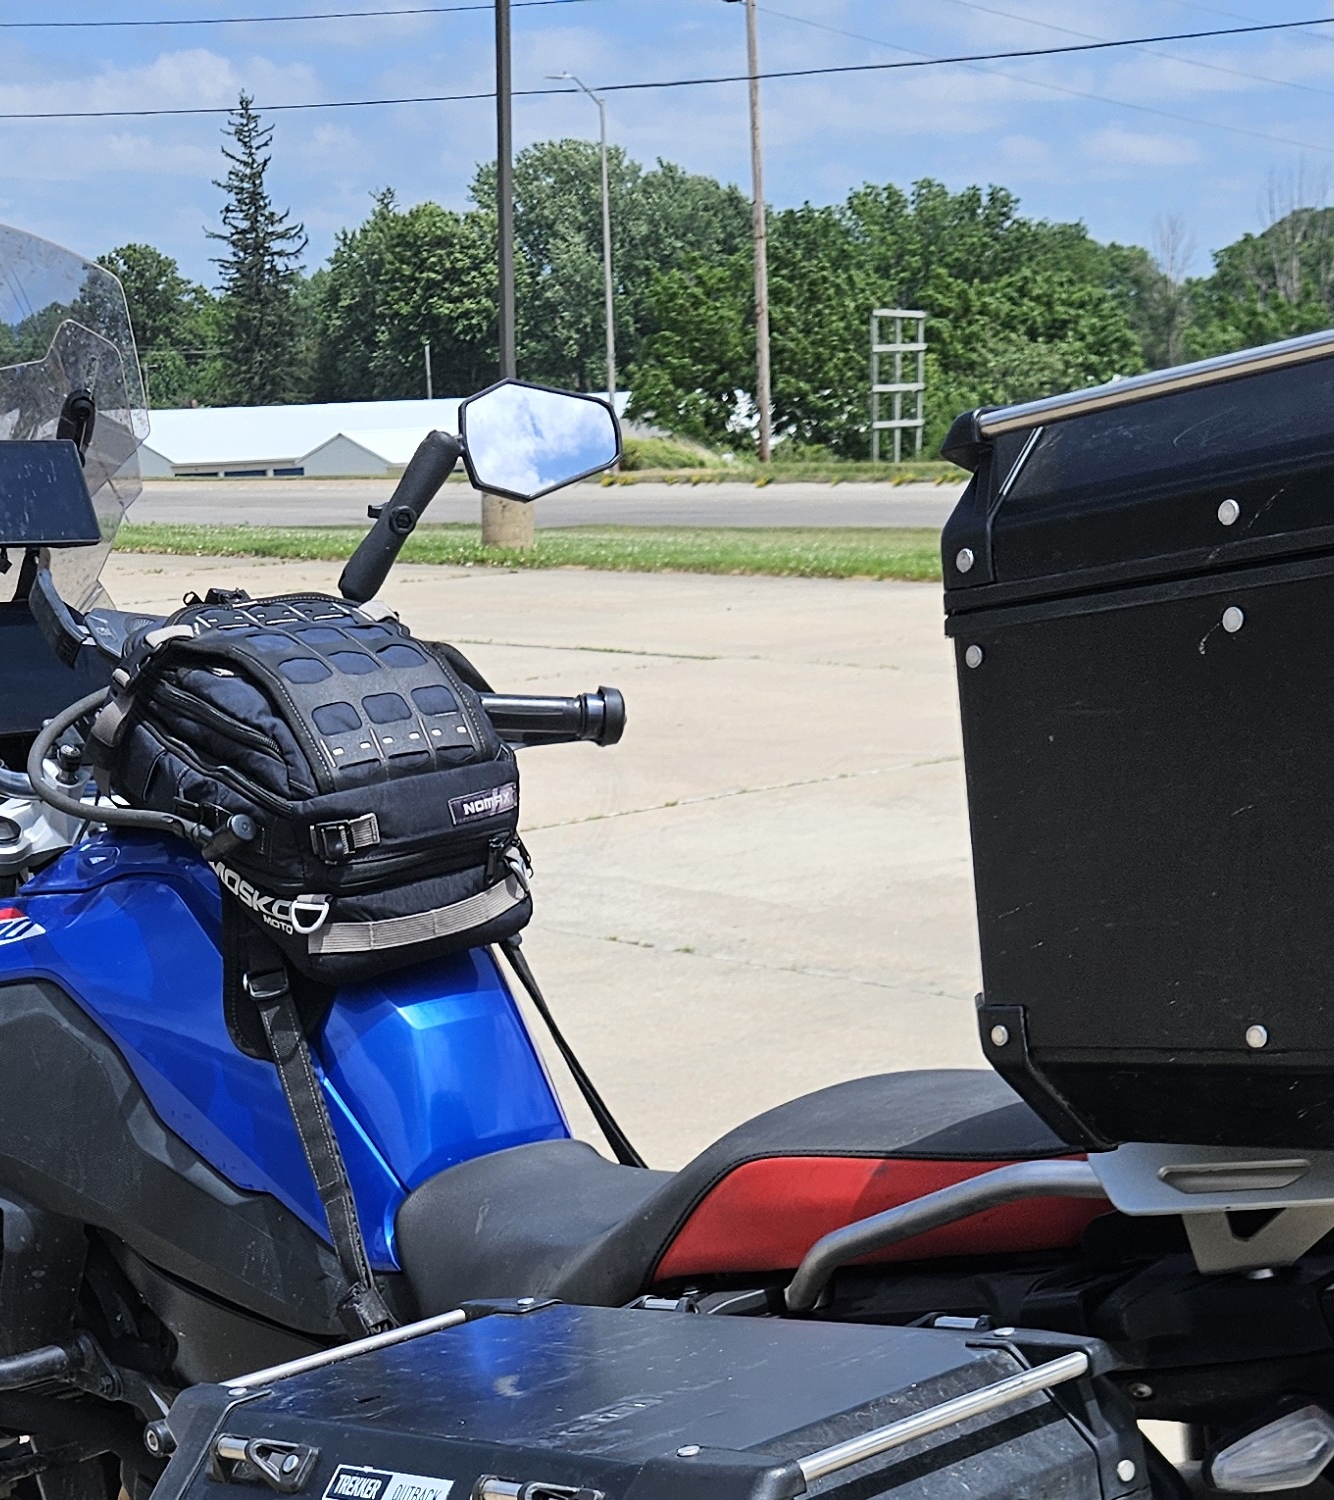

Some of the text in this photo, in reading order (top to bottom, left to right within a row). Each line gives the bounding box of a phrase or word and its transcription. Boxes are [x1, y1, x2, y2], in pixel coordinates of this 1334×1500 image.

[208, 861, 293, 922] MOSKO
[263, 914, 294, 935] MOTO
[333, 1474, 383, 1500] TREKKER
